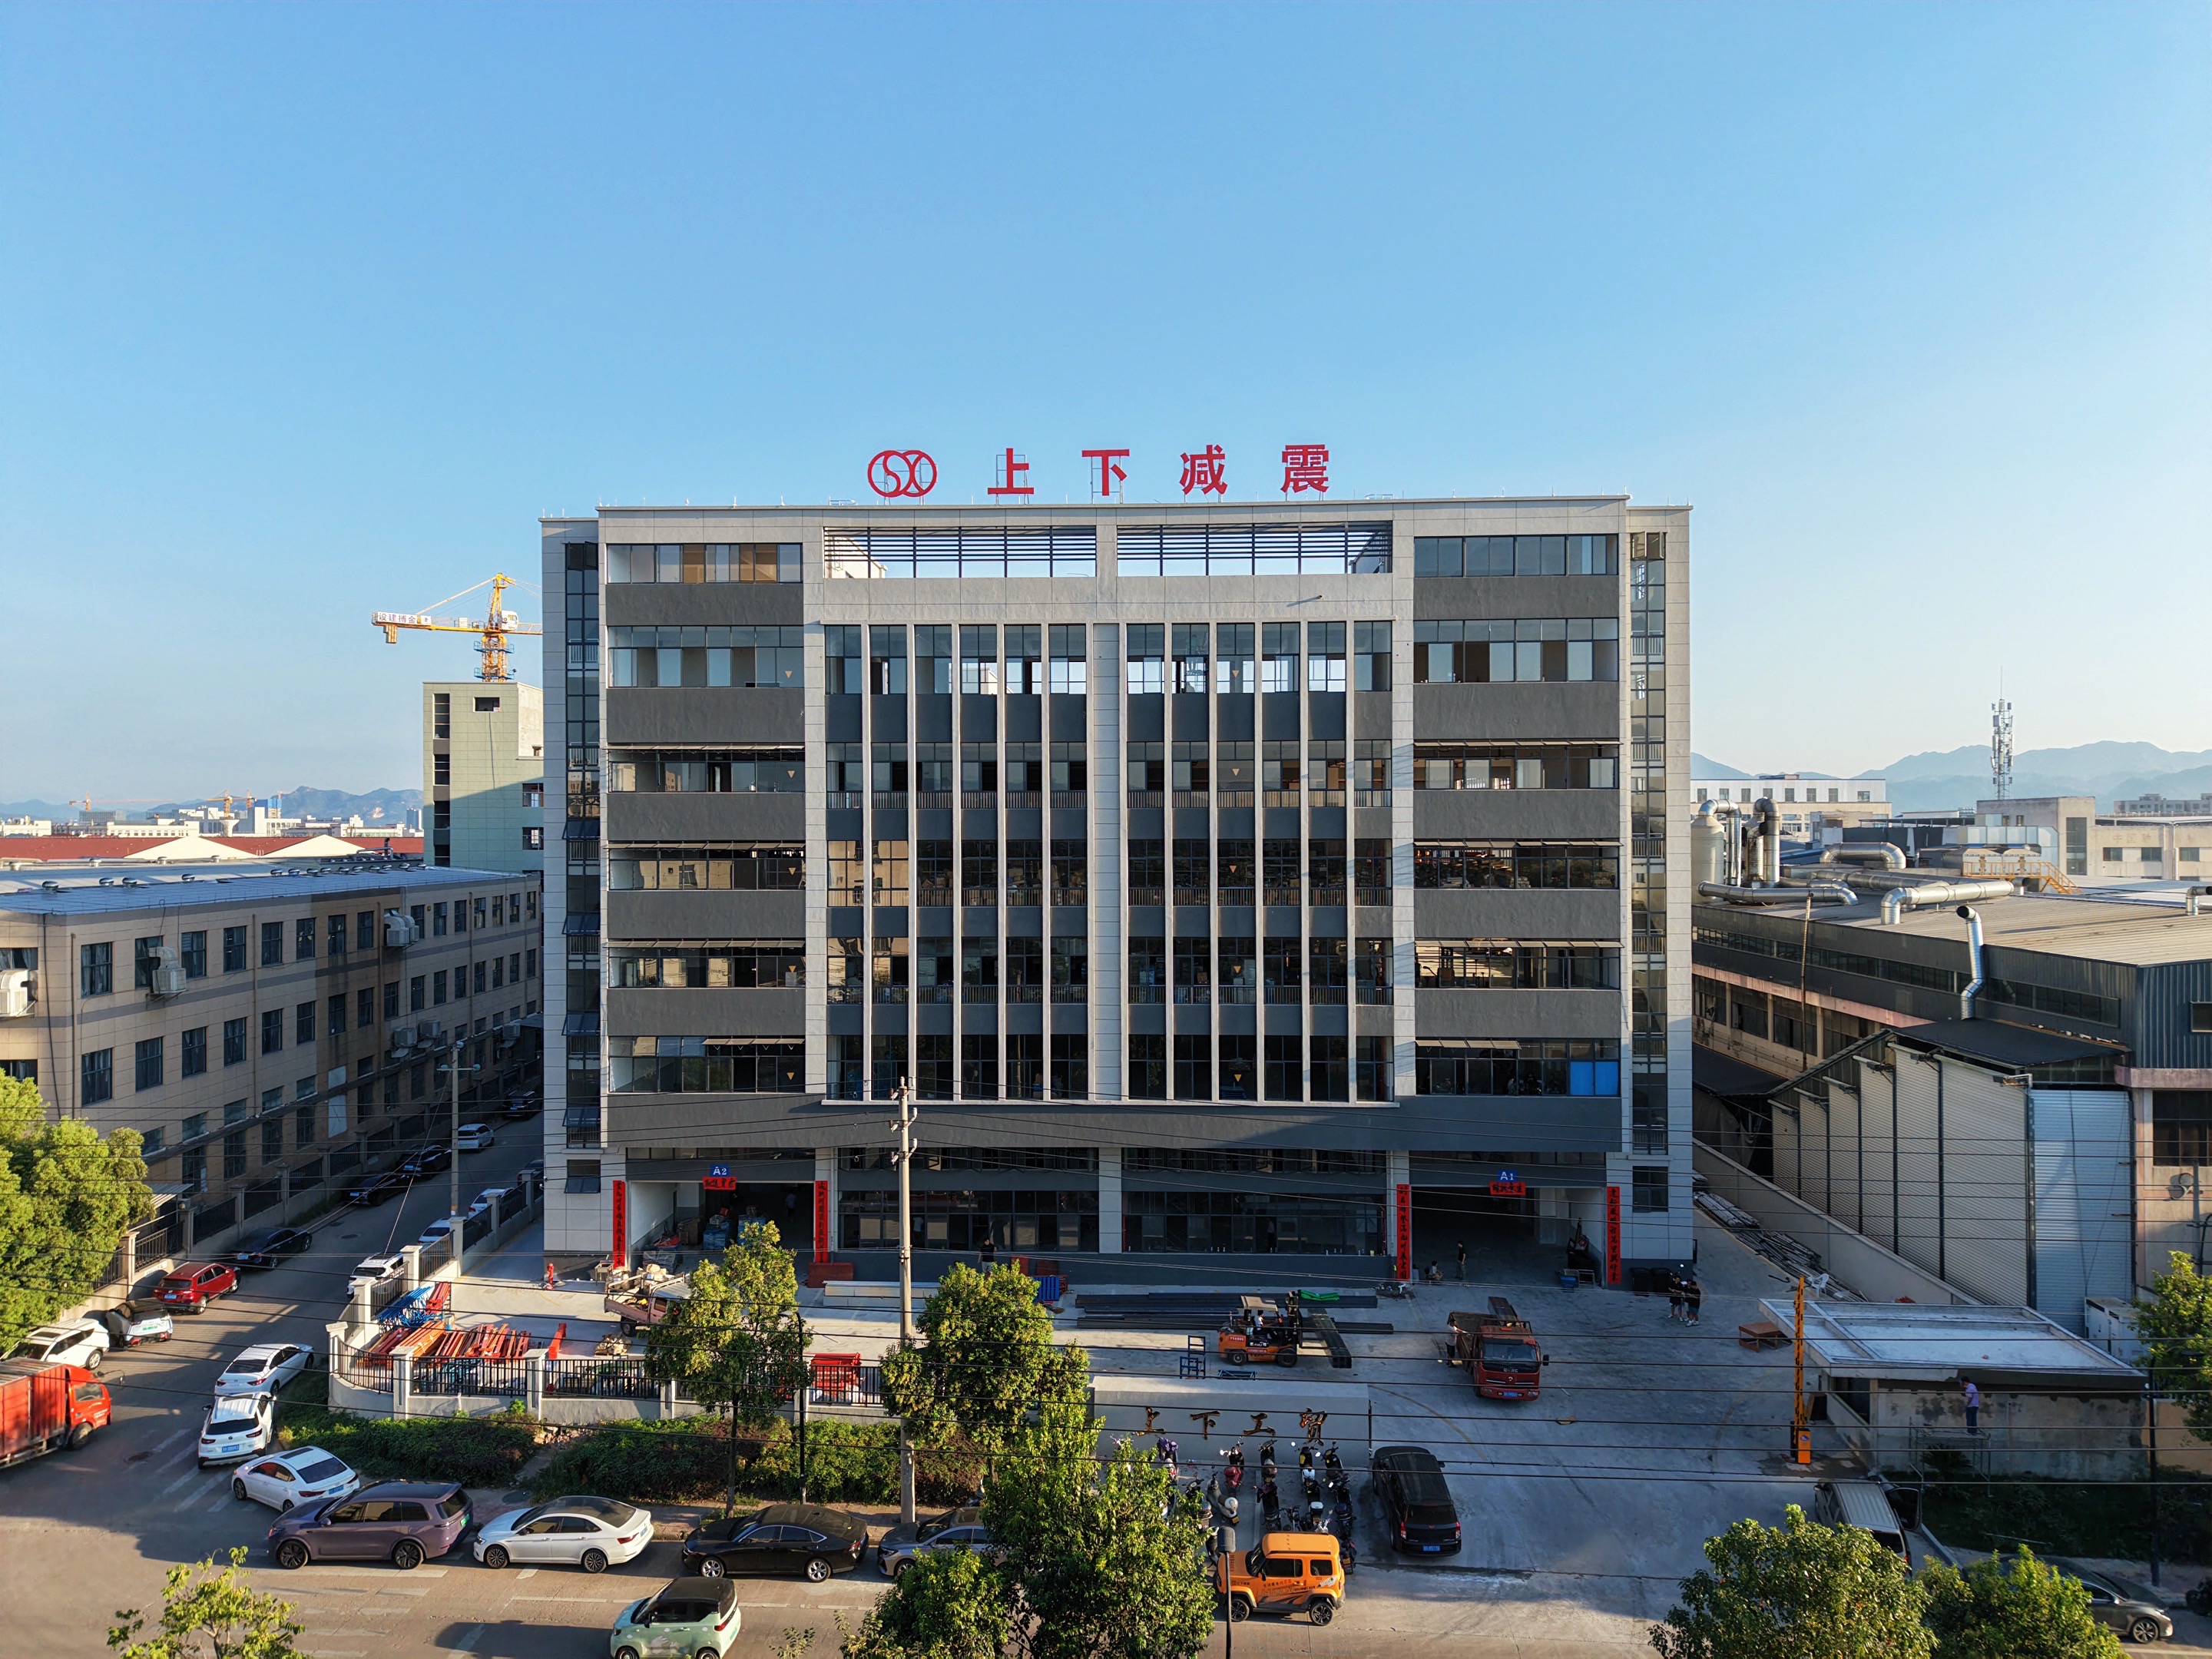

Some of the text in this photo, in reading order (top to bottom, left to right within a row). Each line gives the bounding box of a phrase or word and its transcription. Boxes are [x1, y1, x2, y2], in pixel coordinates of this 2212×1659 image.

[987, 444, 1330, 496] 上下减震
[713, 1166, 727, 1176] A2
[1500, 1171, 1515, 1181] A1
[1136, 1406, 1328, 1447] 上下工贸
